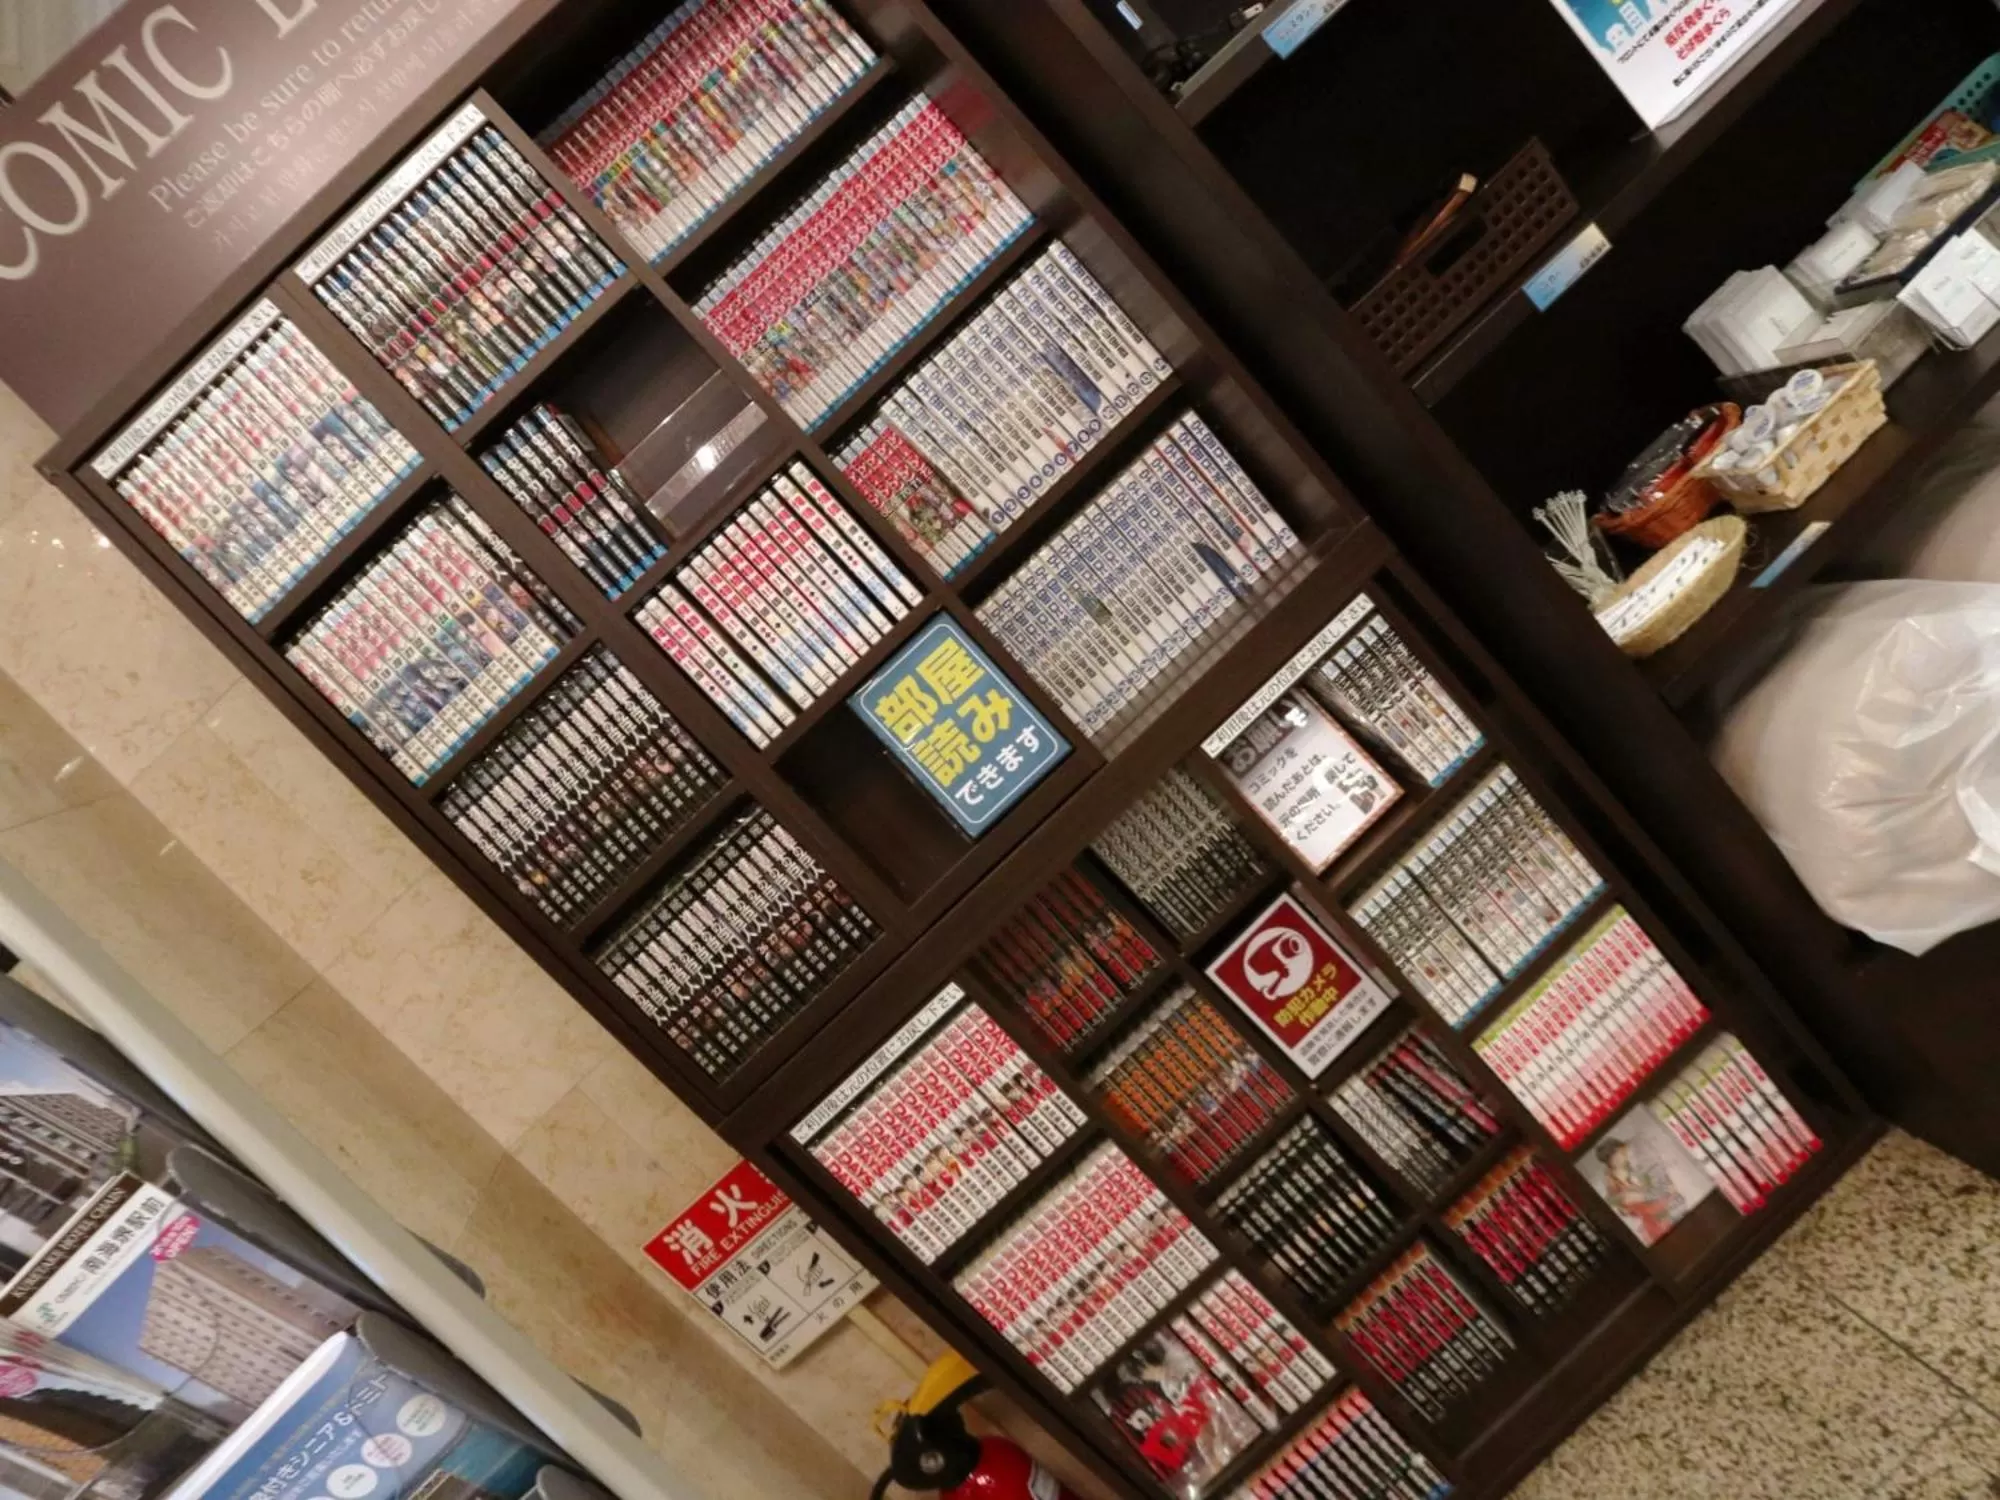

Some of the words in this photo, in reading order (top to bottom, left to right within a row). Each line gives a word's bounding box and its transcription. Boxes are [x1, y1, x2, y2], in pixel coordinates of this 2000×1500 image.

[148, 133, 232, 213] Please
[222, 105, 264, 144] be
[260, 61, 315, 115] sure
[311, 36, 343, 67] to
[1028, 272, 1085, 333] 宇宙兄弟
[976, 322, 1033, 381] 宇宙兄弟
[612, 665, 671, 723] の巨人
[871, 634, 986, 745] 部屋
[1205, 597, 1372, 754] ご利用後は元の位置にお戻し下さい
[577, 697, 635, 756] の巨人
[600, 676, 658, 735] の巨人
[910, 678, 1022, 789] 読み
[542, 730, 600, 790] の巨人
[566, 708, 624, 768] の巨人
[953, 722, 1047, 811] できます
[519, 751, 578, 810] の巨人
[531, 740, 589, 800] の巨人
[1248, 745, 1299, 795] コミックを
[487, 782, 548, 841] の巨人
[497, 774, 556, 832] の巨人
[452, 814, 513, 872] の巨人
[464, 804, 524, 862] の巨人
[757, 832, 815, 890] の巨人
[734, 855, 790, 913] の巨人
[745, 844, 802, 901] の巨人
[701, 886, 759, 943] の巨人
[711, 876, 769, 934] の巨人
[666, 918, 724, 975] の巨人
[677, 907, 734, 964] の巨人
[621, 961, 679, 1017] の巨人
[633, 949, 691, 1006] の巨人
[643, 939, 701, 994] の巨人
[1273, 961, 1339, 1027] 防犯カメラ
[793, 986, 961, 1140] ご利用後は元の位置にお戻し下さい
[959, 1038, 996, 1076] DAYS
[970, 1028, 1008, 1067] DAYS
[981, 1018, 1019, 1056] DAYS
[924, 1071, 961, 1109] DAYS
[935, 1061, 972, 1098] DAYS
[948, 1049, 986, 1086] DAYS
[892, 1101, 930, 1140] DAYS
[902, 1091, 940, 1129] DAYS
[913, 1081, 951, 1119] DAYS
[869, 1121, 906, 1159] DAYS
[880, 1110, 918, 1149] DAYS
[826, 1160, 865, 1197] DAYS
[837, 1150, 875, 1187] DAYS
[89, 1186, 125, 1221] CHAIN
[661, 1160, 772, 1264] 消火
[690, 1247, 721, 1276] FIRE
[703, 1256, 751, 1299] 使用法
